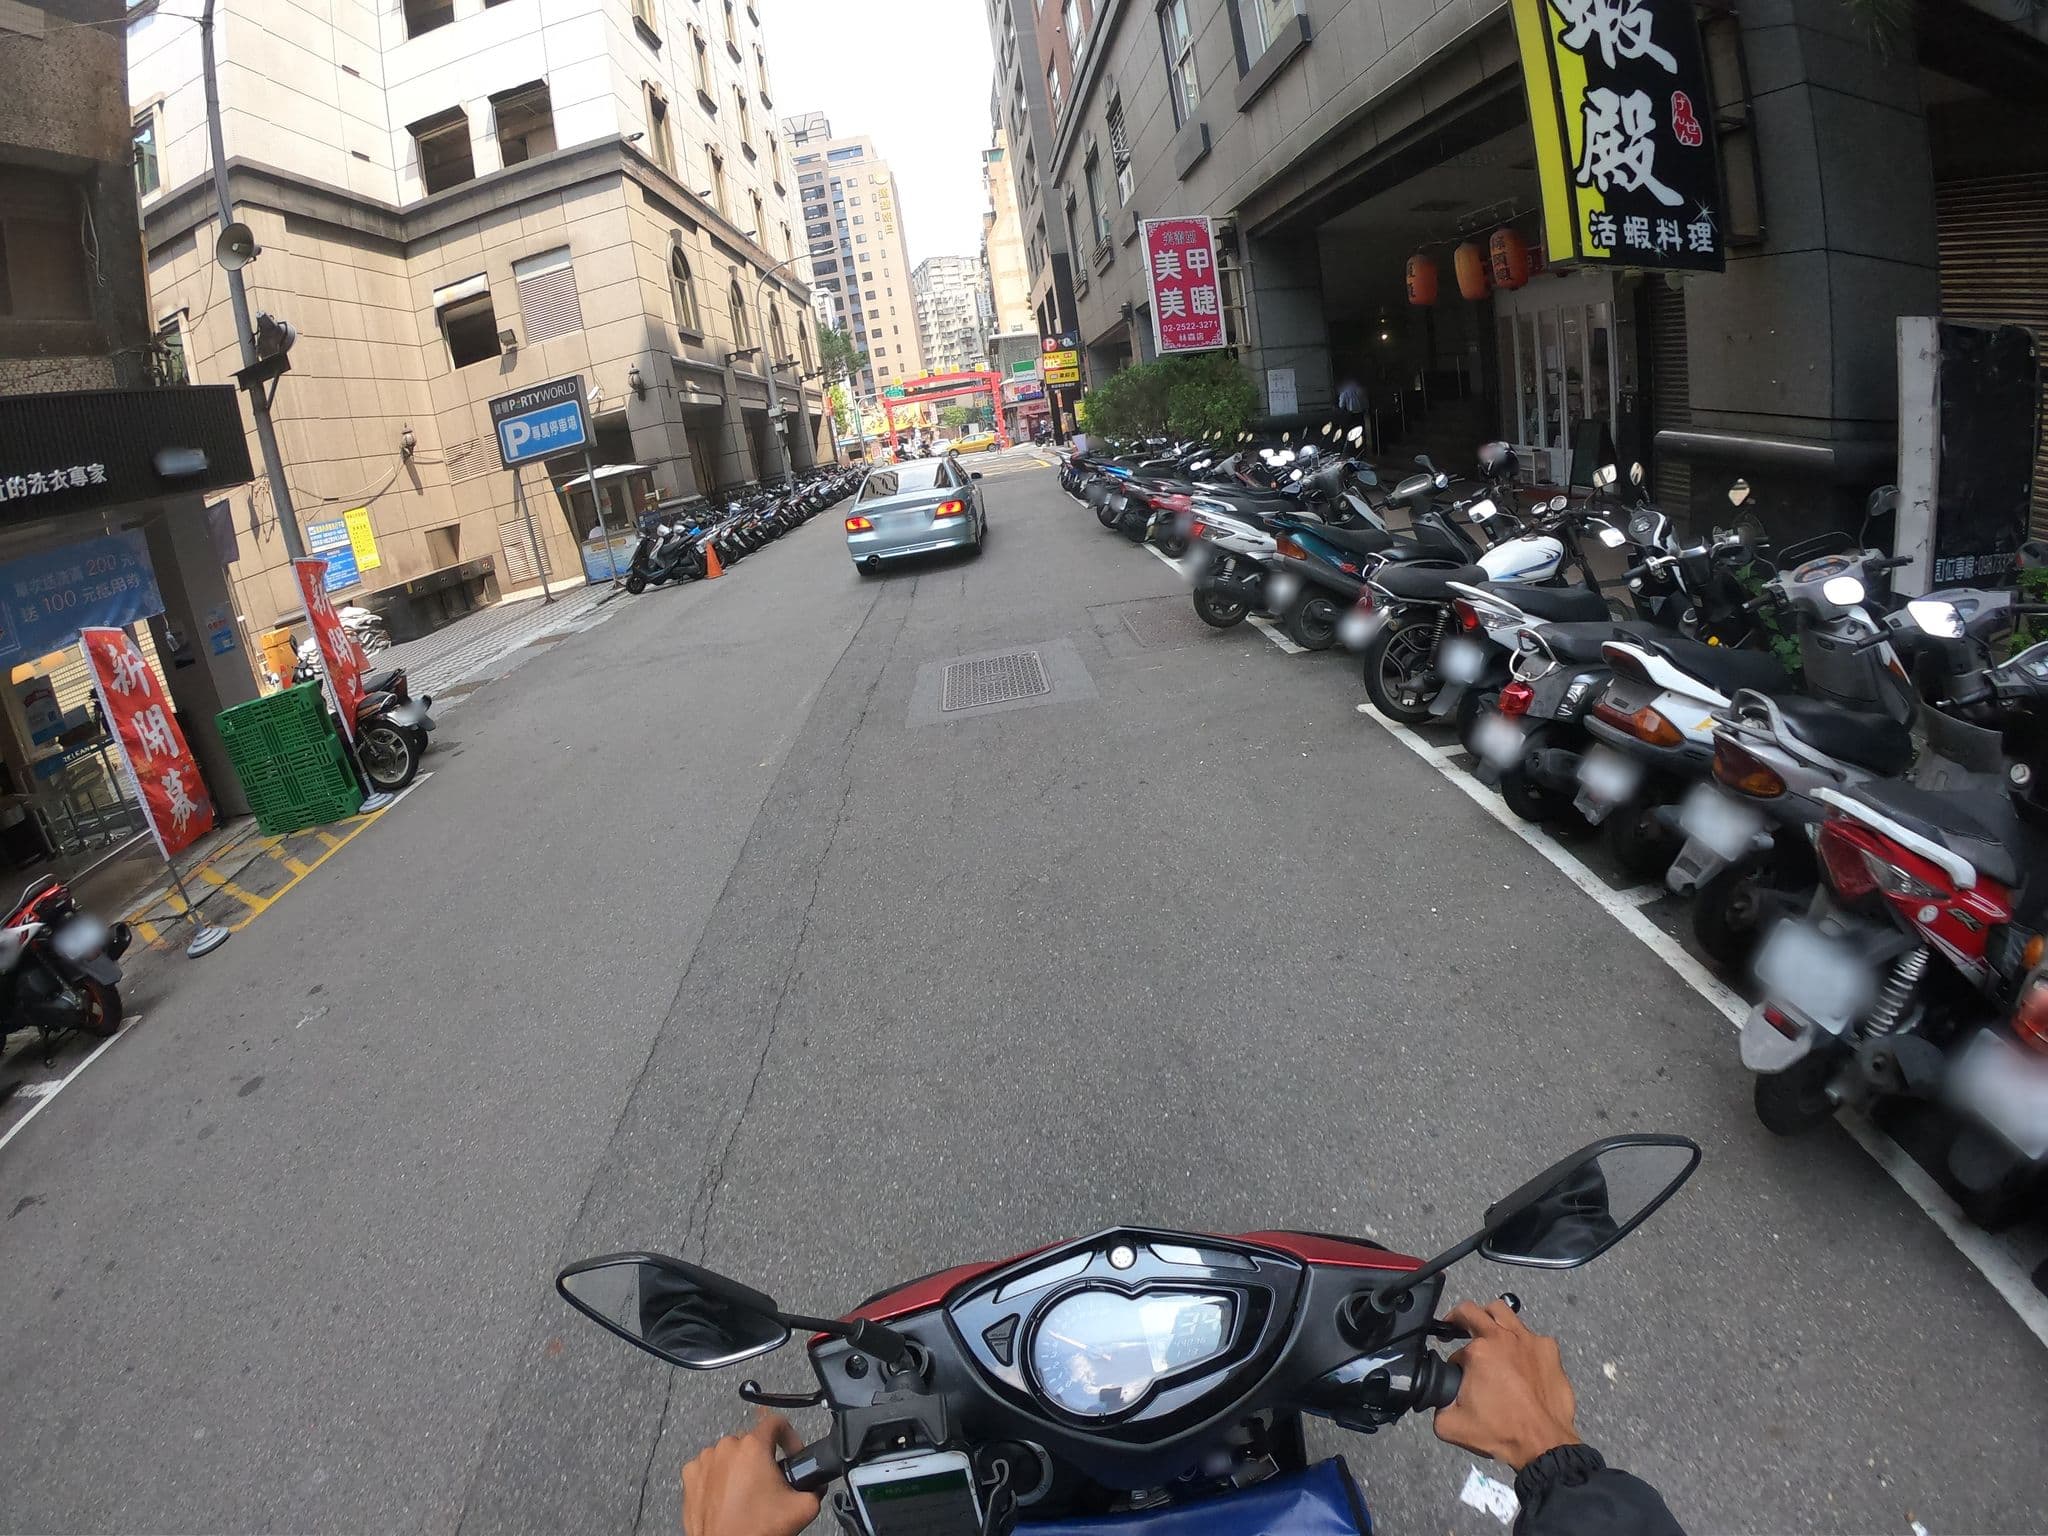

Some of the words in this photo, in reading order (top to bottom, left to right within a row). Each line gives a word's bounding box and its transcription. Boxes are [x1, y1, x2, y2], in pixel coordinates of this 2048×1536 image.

[1589, 211, 1715, 253] 活蝦料理
[1154, 248, 1210, 281] 美甲
[1160, 284, 1218, 319] 美睫
[1162, 320, 1218, 332] 02-2522-3271
[504, 421, 531, 458] P
[43, 589, 77, 613] 100
[107, 643, 198, 833] 新開幕
